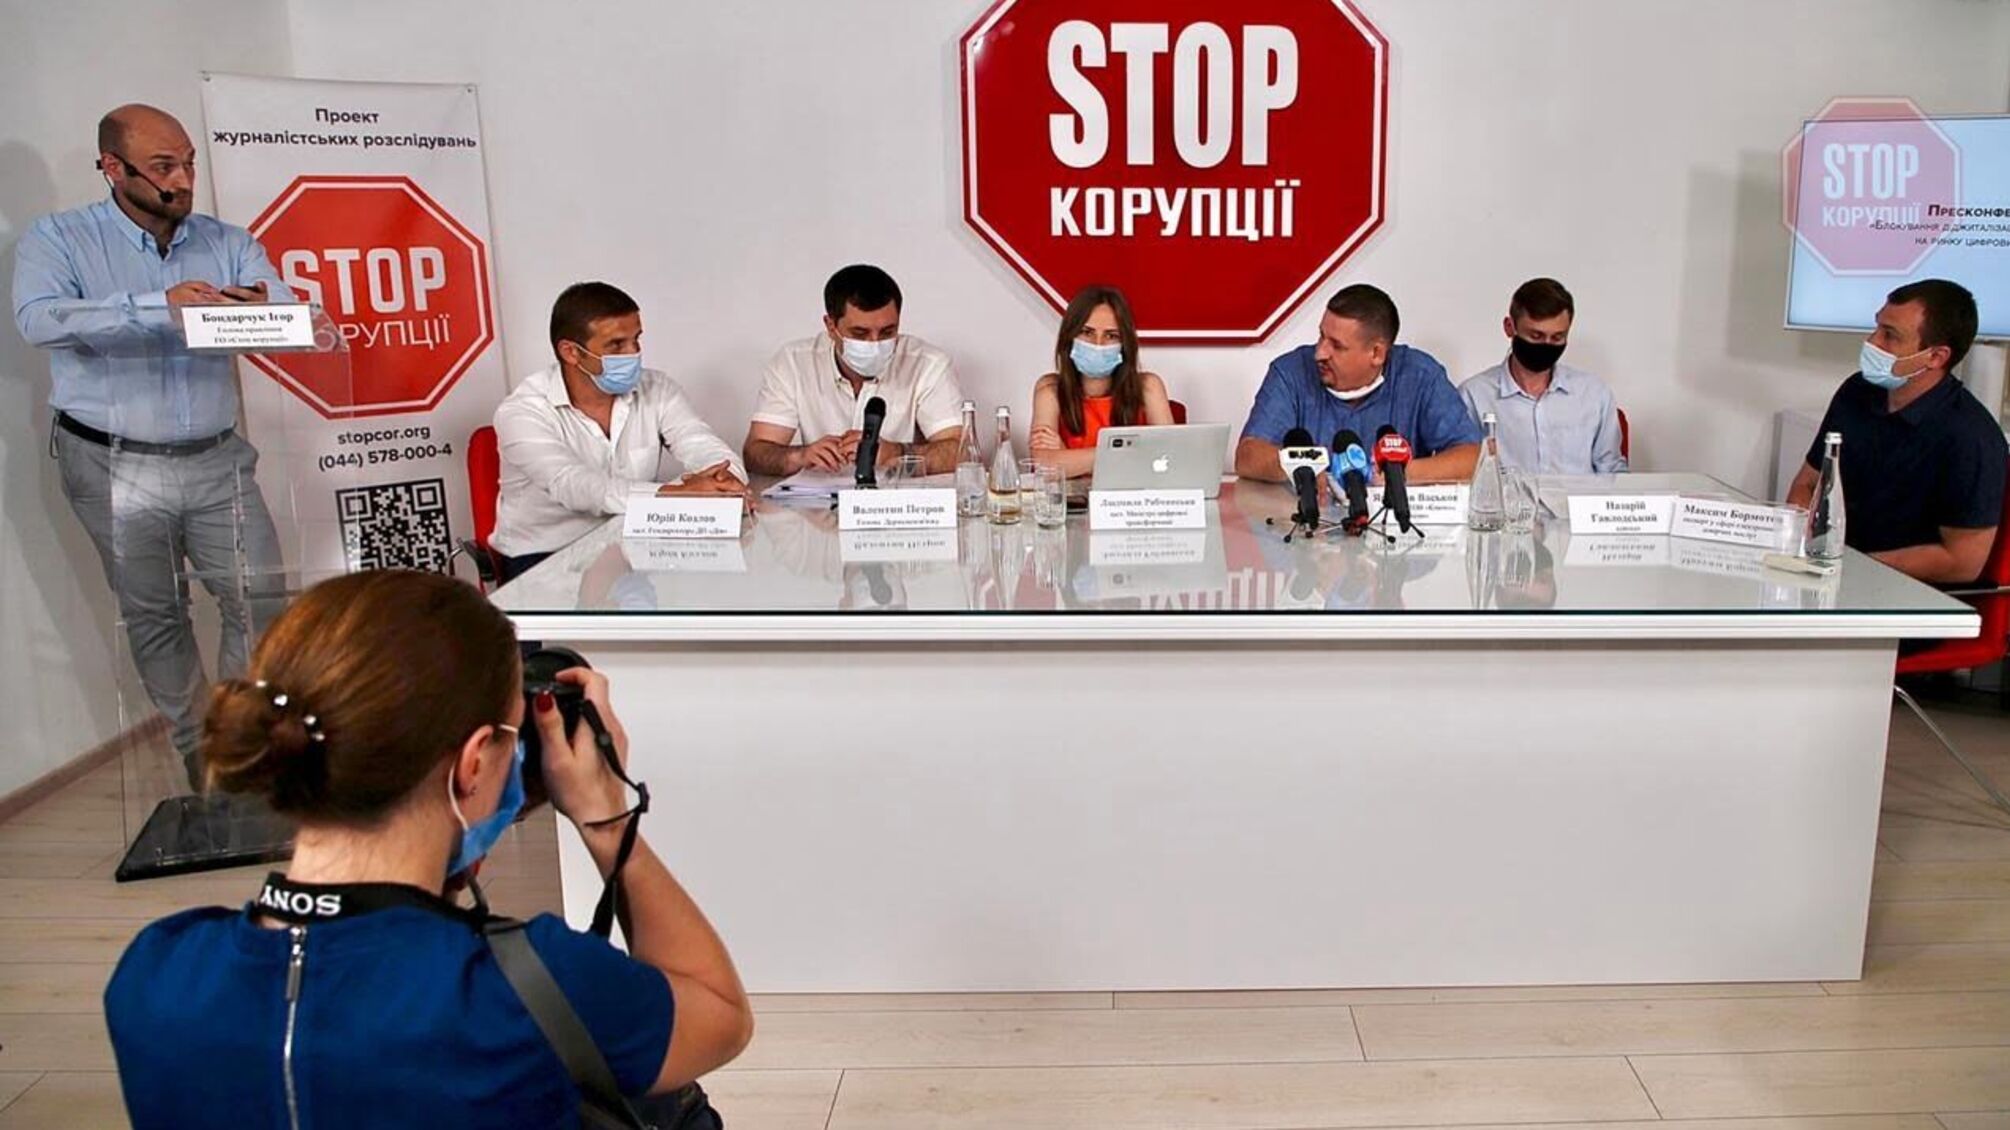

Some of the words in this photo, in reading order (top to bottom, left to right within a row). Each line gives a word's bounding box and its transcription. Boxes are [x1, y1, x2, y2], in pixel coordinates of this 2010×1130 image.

[1047, 20, 1298, 168] STOP
[314, 107, 379, 125] Проект
[213, 130, 358, 146] журналістських
[363, 134, 476, 148] розслідувань
[1050, 179, 1301, 241] КОРУПЦІЇ
[202, 313, 266, 324] Бондарчук
[338, 314, 450, 350] РУПЦІЇ
[338, 427, 431, 445] stopcor.org
[319, 453, 363, 472] (044)
[368, 443, 452, 464] 578-000-4
[647, 513, 676, 524] Юрій
[260, 885, 341, 916] SONY
